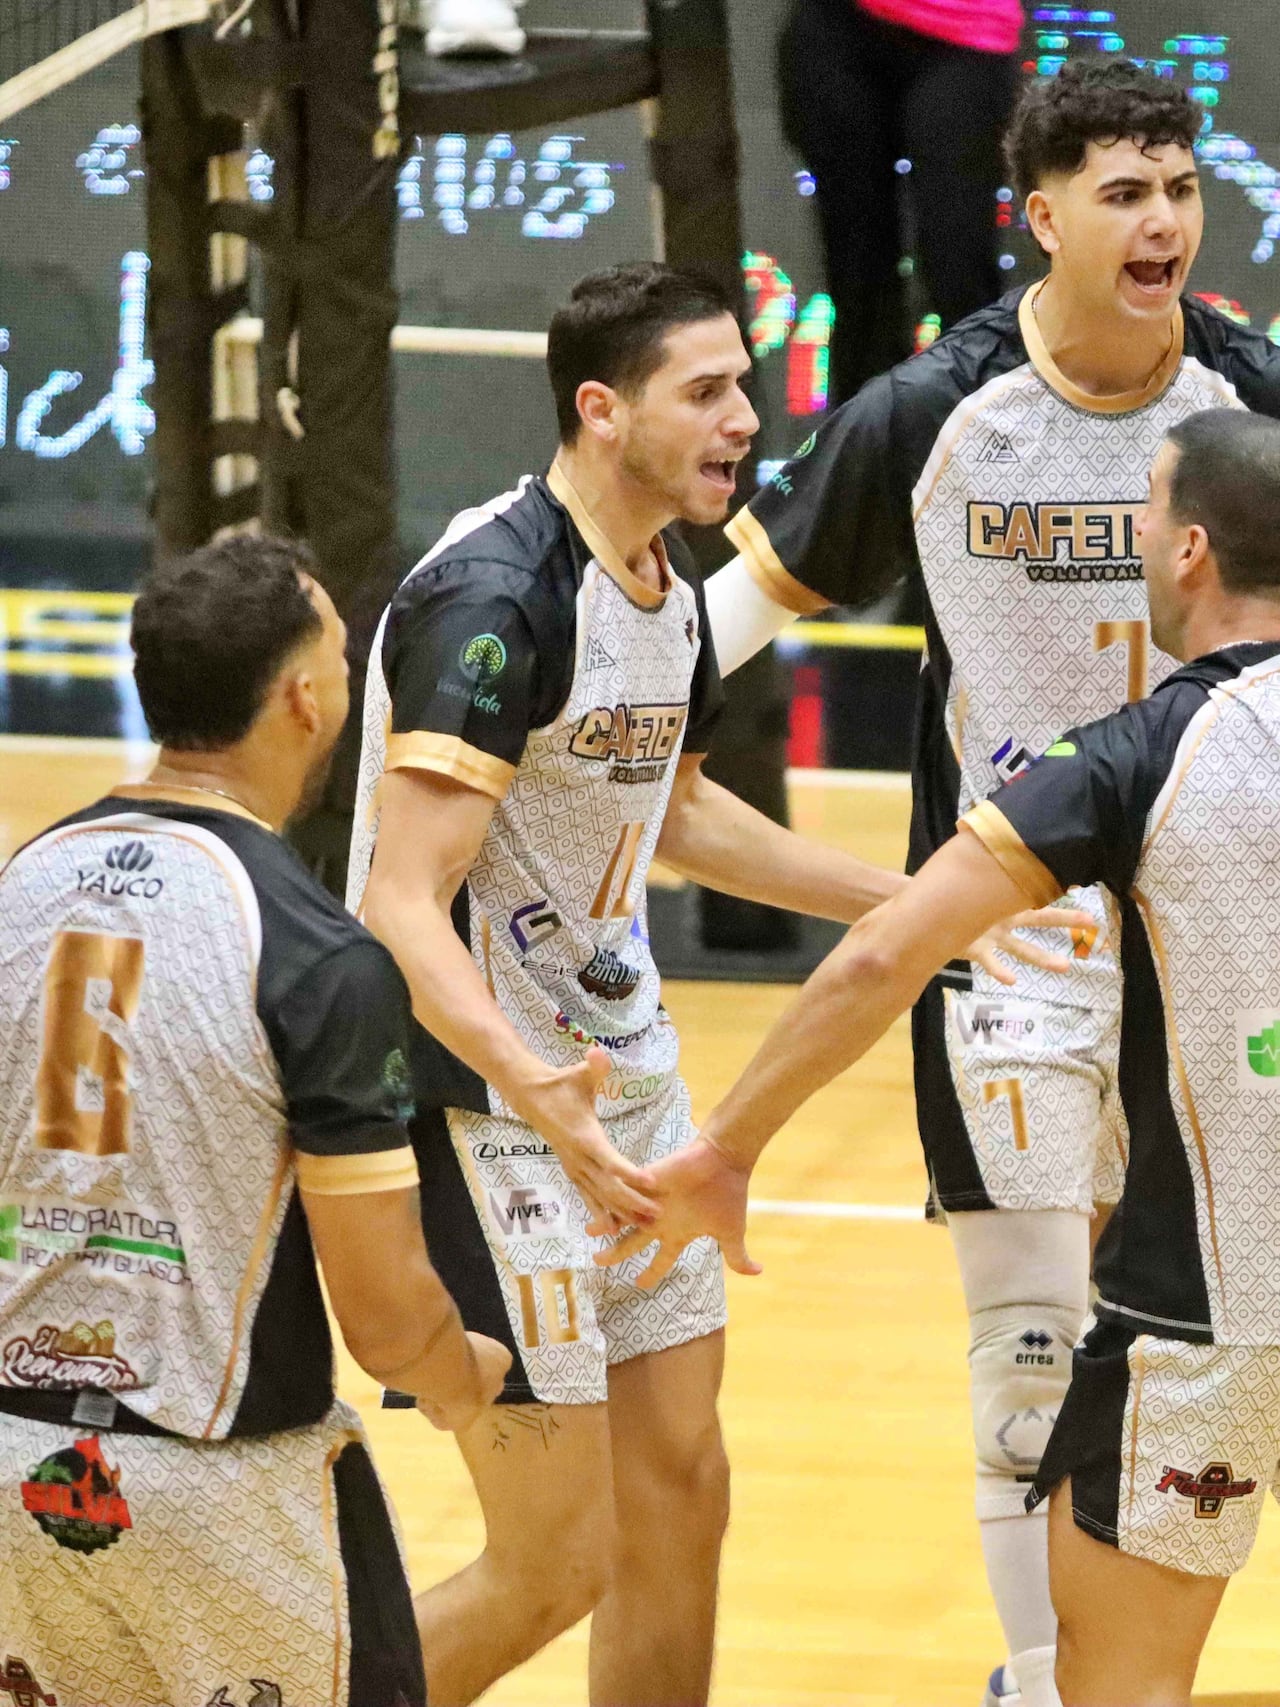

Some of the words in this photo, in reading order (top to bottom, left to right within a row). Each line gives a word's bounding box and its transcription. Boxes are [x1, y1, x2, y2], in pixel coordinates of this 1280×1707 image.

[967, 501, 1149, 561] CAFET
[76, 870, 164, 899] YAUCO
[34, 929, 147, 1157] 6
[515, 1269, 580, 1348] 10
[1015, 1352, 1054, 1365] errea
